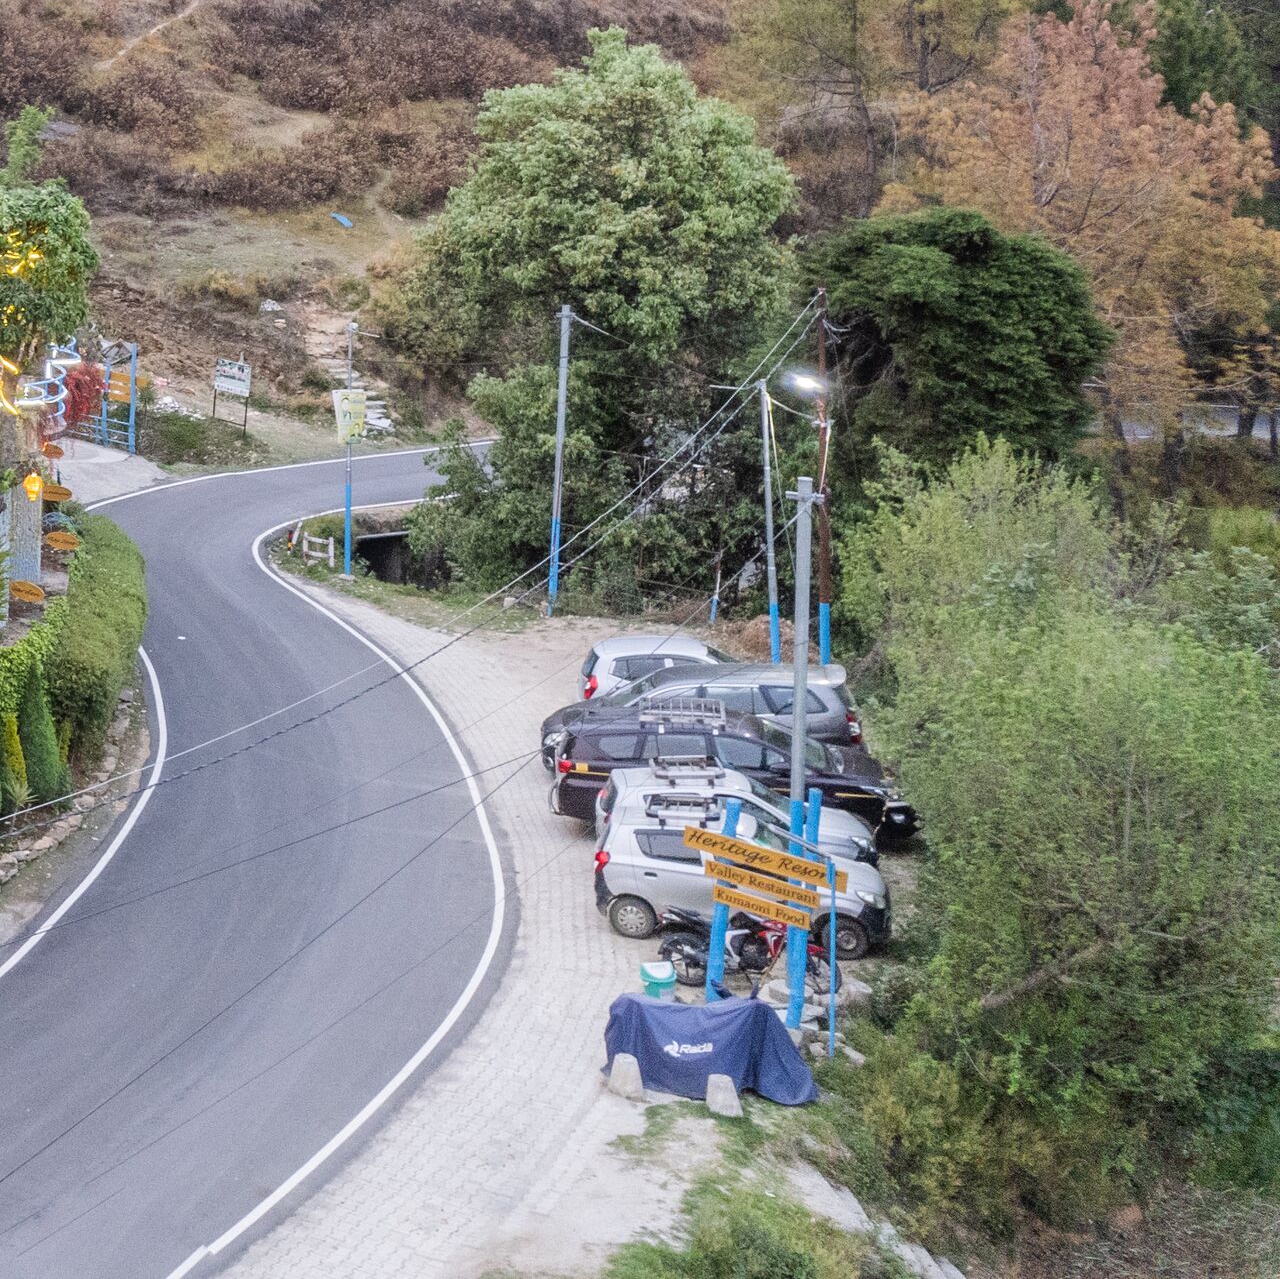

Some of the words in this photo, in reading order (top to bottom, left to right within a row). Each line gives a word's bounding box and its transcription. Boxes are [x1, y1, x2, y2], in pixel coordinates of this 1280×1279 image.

[688, 829, 773, 865] Heritage
[709, 864, 745, 883] Valley
[749, 875, 817, 904] Restaurant
[717, 889, 770, 915] Kumaoni
[776, 908, 806, 927] Food
